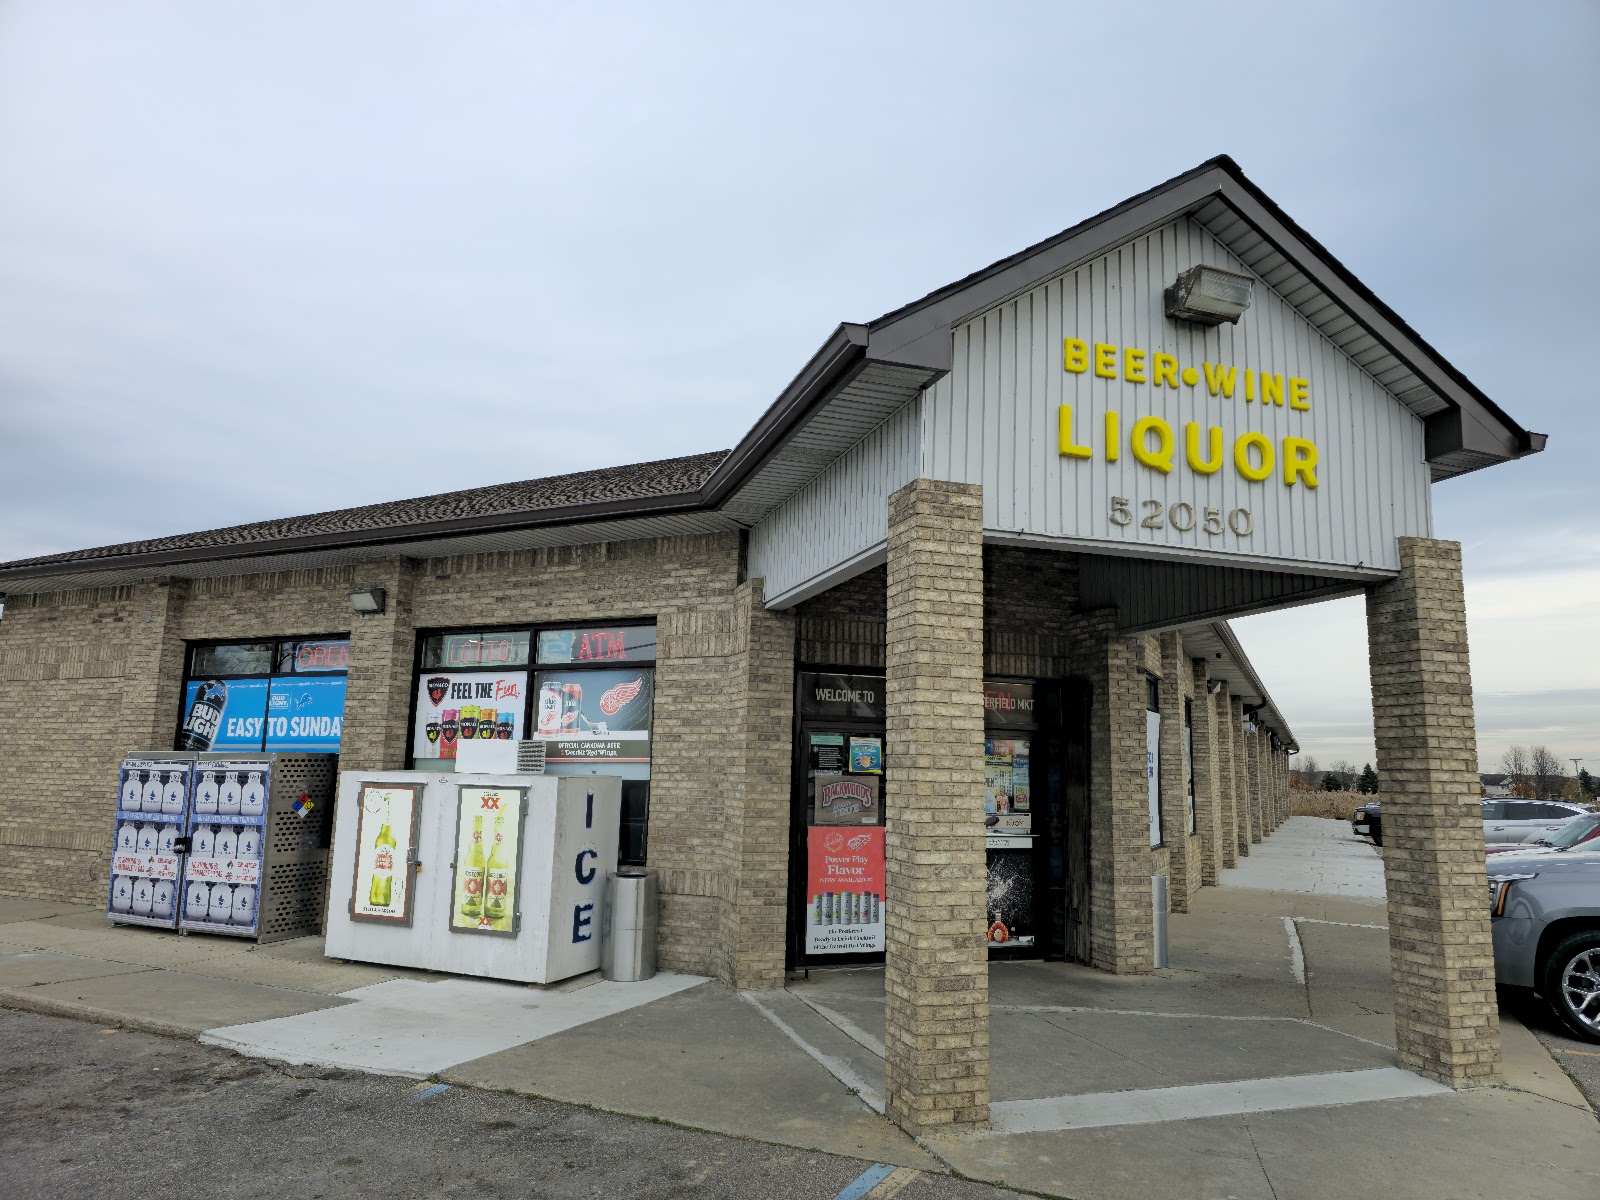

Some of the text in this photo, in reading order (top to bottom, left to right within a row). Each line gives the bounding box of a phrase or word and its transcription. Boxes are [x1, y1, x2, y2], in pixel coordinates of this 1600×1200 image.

[1063, 336, 1311, 411] BEER WINE
[1058, 403, 1319, 489] LIQUOR
[1109, 495, 1254, 538] 52050
[298, 644, 350, 667] OPEN
[450, 639, 510, 664] LOTTO
[579, 631, 627, 660] ATM
[450, 682, 473, 700] FEEL
[475, 682, 494, 699] THE
[815, 688, 875, 704] WELCOME TO
[192, 703, 221, 725] BUD
[984, 696, 1034, 711] ERFIELD MKT
[183, 716, 219, 739] LIGH
[226, 716, 343, 738] EASY TO SUNDA
[480, 796, 501, 810] XX
[822, 781, 872, 809] BACKWOODS
[825, 855, 868, 865] Power Play
[827, 864, 865, 875] Flavor
